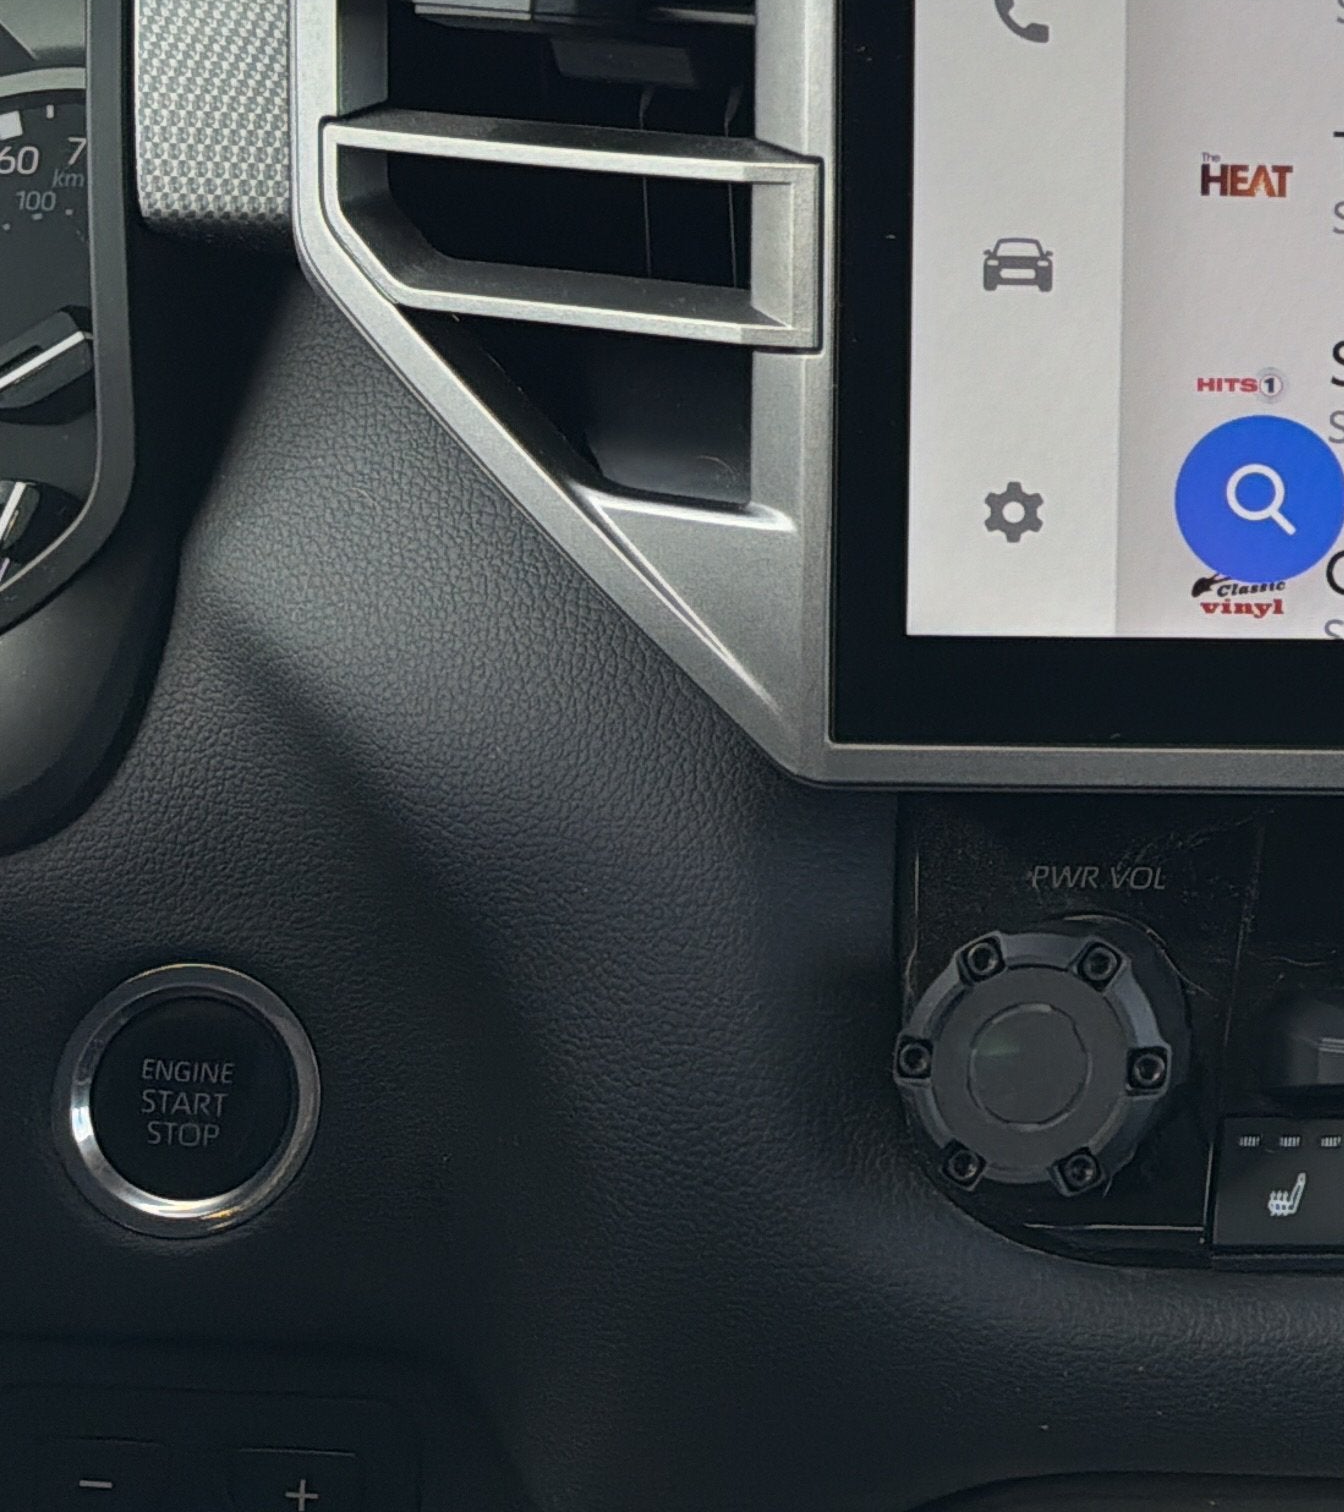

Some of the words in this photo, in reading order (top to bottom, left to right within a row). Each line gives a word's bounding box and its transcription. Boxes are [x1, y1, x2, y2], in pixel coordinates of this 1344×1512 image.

[1200, 163, 1294, 198] HEAT
[16, 190, 57, 212] 100
[1196, 377, 1258, 392] HITS
[1200, 598, 1284, 619] vinyl
[1032, 865, 1099, 888] PWR
[1110, 866, 1166, 890] VOL
[141, 1058, 235, 1084] ENGINE
[141, 1088, 228, 1117] START
[147, 1120, 220, 1147] STOP
